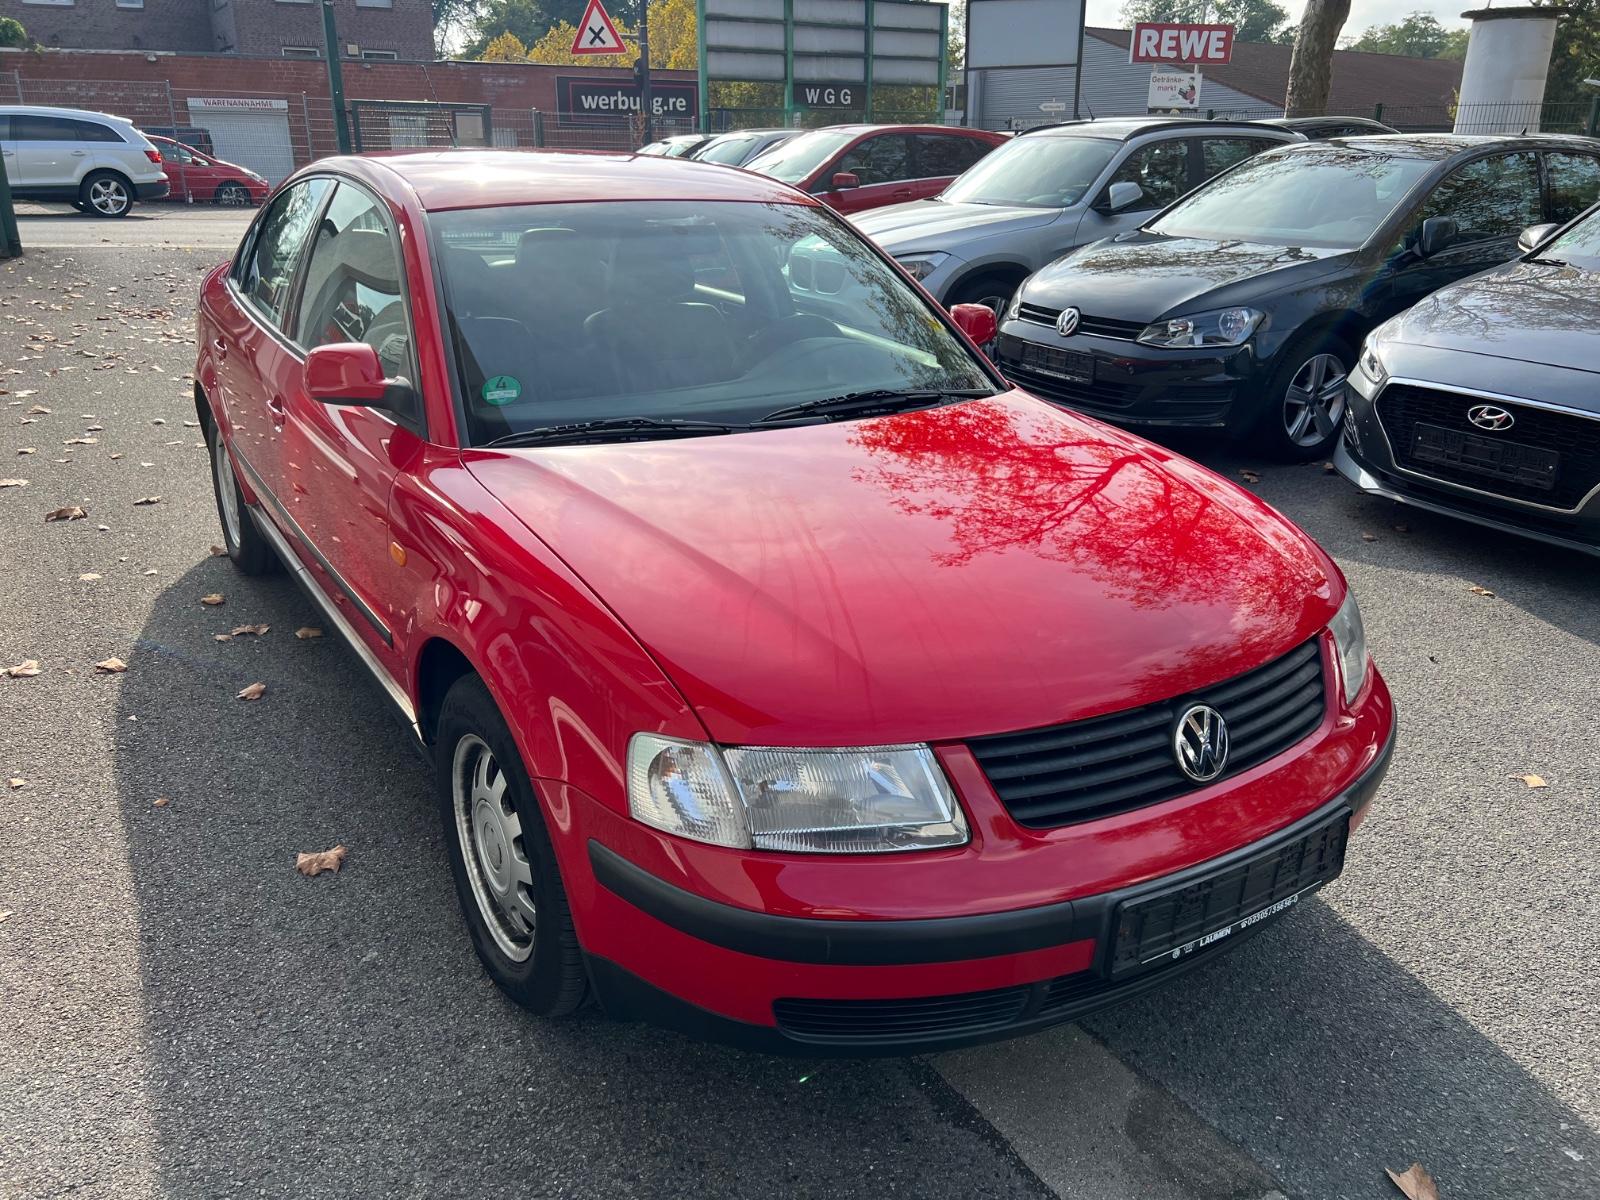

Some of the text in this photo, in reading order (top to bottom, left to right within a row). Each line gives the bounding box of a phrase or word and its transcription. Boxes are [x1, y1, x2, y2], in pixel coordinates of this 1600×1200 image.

[1138, 29, 1227, 60] REWE
[203, 99, 273, 108] WARENANNAHME
[496, 376, 507, 389] 4
[1200, 926, 1232, 947] LAUMEN
